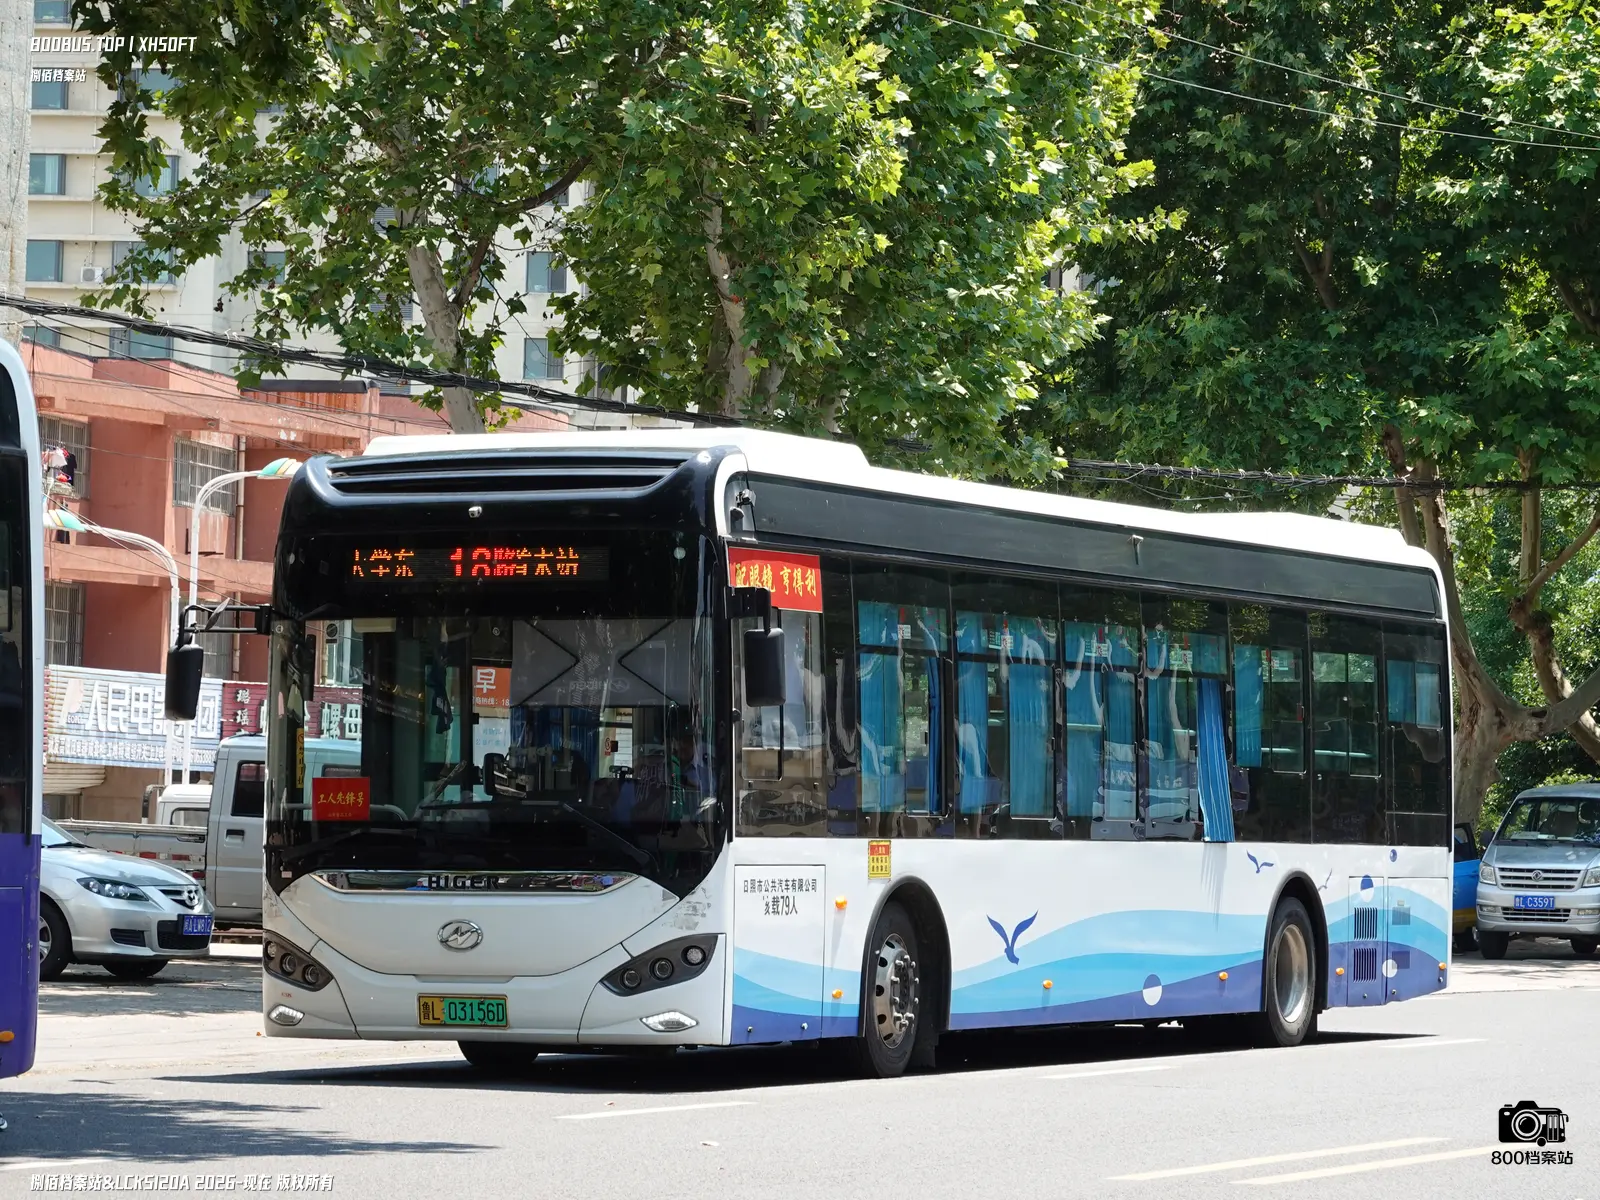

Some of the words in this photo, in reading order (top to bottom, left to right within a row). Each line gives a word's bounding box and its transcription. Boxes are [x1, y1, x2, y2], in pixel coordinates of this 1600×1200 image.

[735, 563, 776, 593] 配眼镜
[780, 566, 817, 597] 亨得利
[474, 668, 497, 694] 早
[85, 680, 219, 739] 人民电器团
[235, 688, 251, 735] 璐瑶
[317, 791, 364, 807] 工人先锋号
[427, 875, 500, 890] HIGER
[743, 878, 817, 893] 日照市公共汽车有限公司
